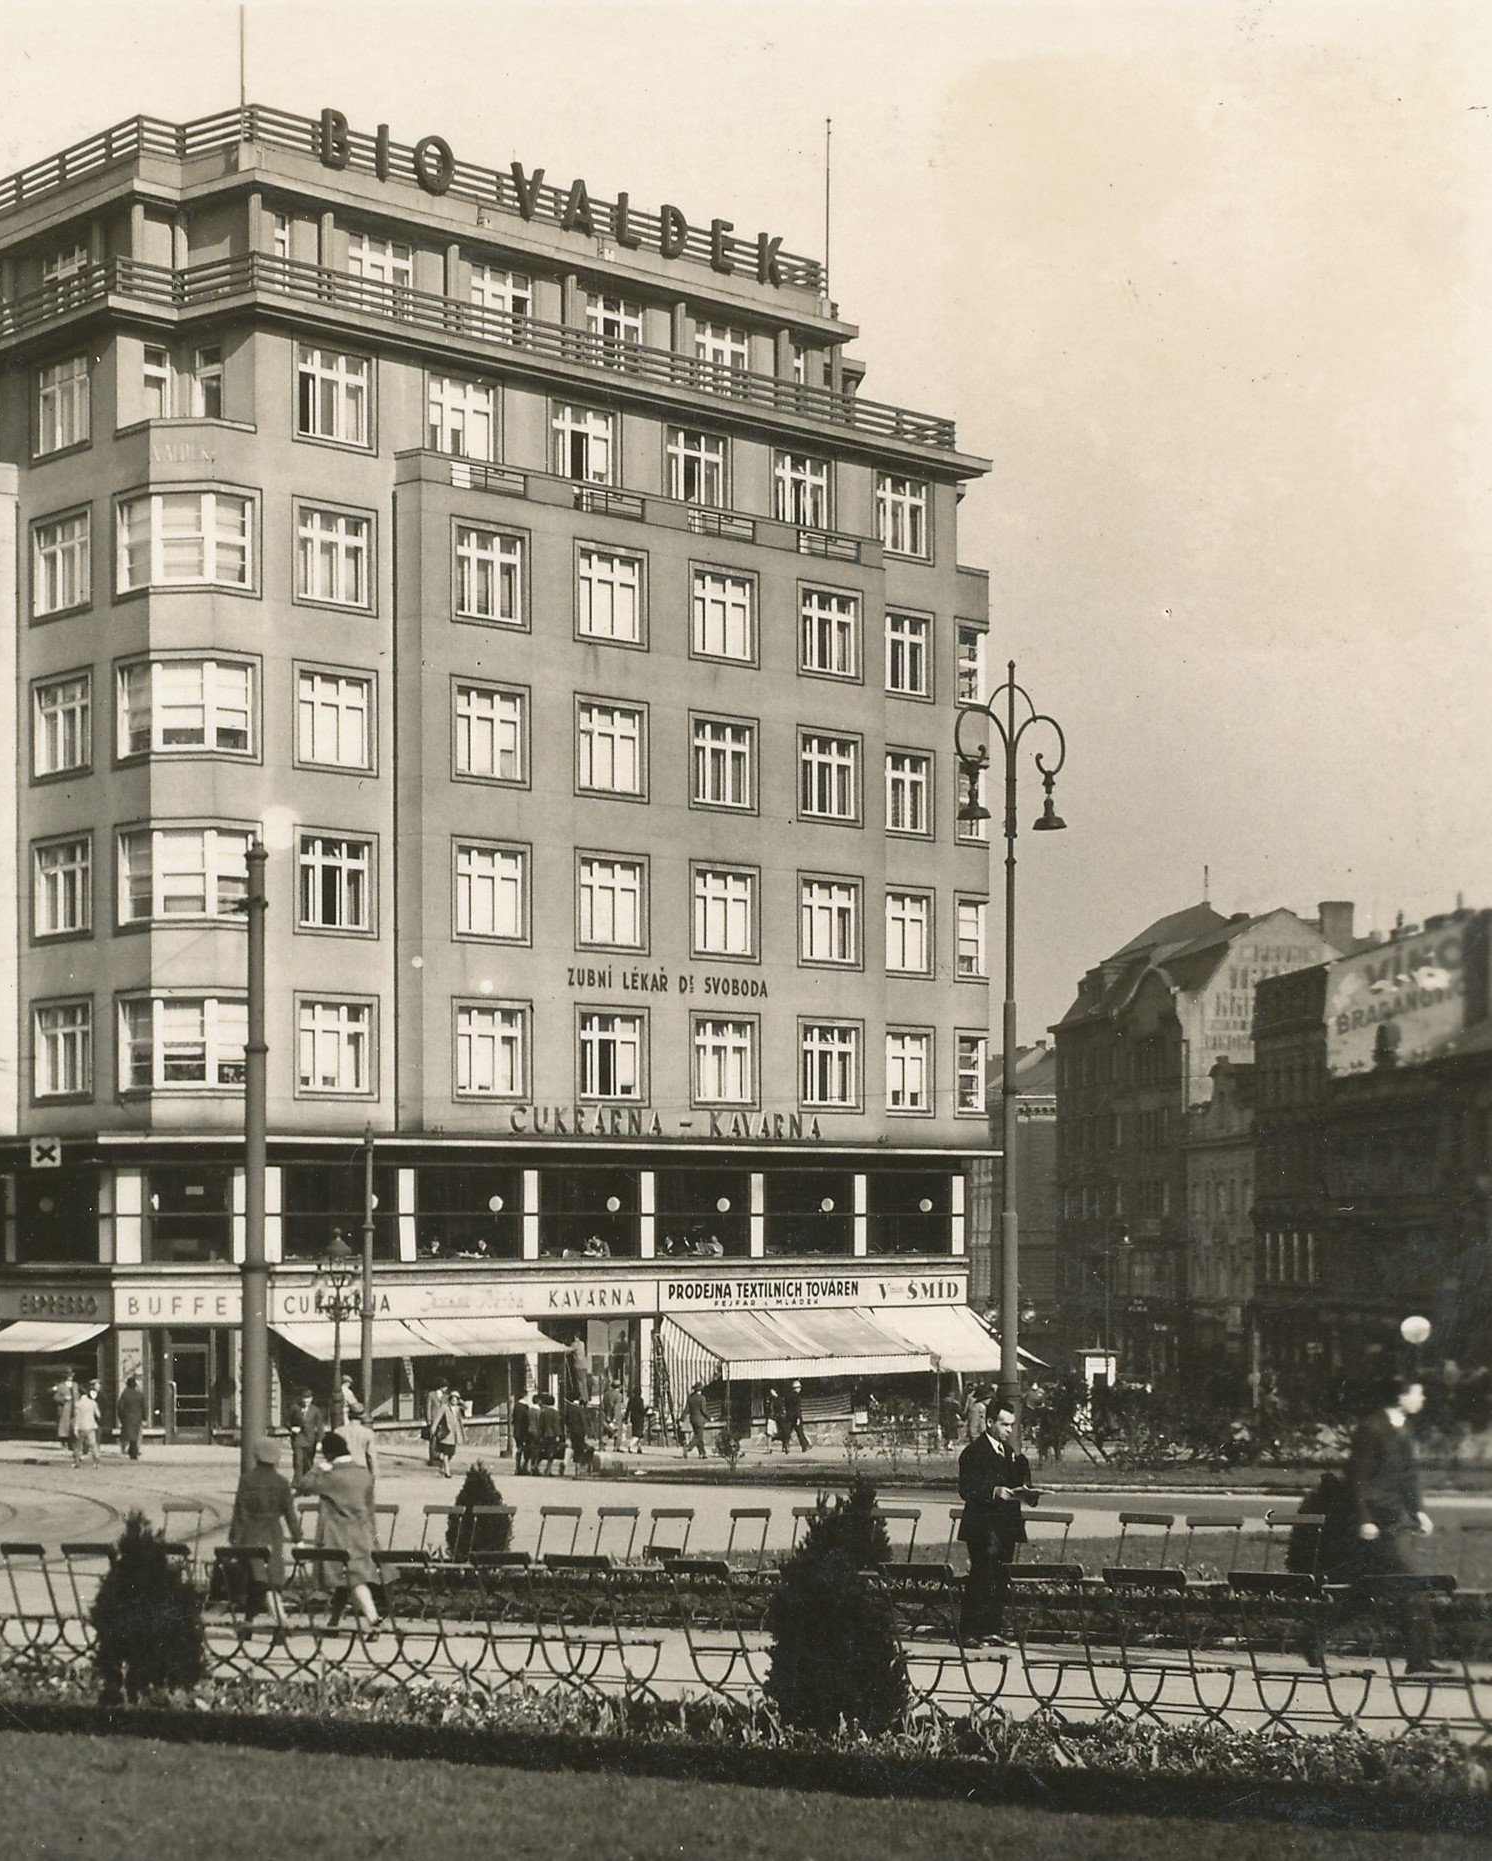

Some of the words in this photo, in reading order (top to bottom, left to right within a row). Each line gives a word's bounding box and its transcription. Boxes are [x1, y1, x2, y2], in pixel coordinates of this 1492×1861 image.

[321, 107, 455, 196] BIO
[510, 161, 783, 288] VALDEK
[567, 964, 612, 989] ZUBNÍ
[622, 966, 668, 992] LÉKAŘ
[704, 976, 768, 999] SVOBODA
[510, 1104, 662, 1137] CUKRÁRNA
[708, 1111, 821, 1139] KAVÁRNA
[549, 1289, 635, 1308] KAVÁRNA
[668, 1280, 732, 1300] PRODEJNA
[736, 1278, 802, 1297] TEXTILNÍCH
[806, 1277, 858, 1295] TOVÁREN
[906, 1278, 959, 1300] ŠMÍD
[128, 1296, 242, 1316] BUFFE
